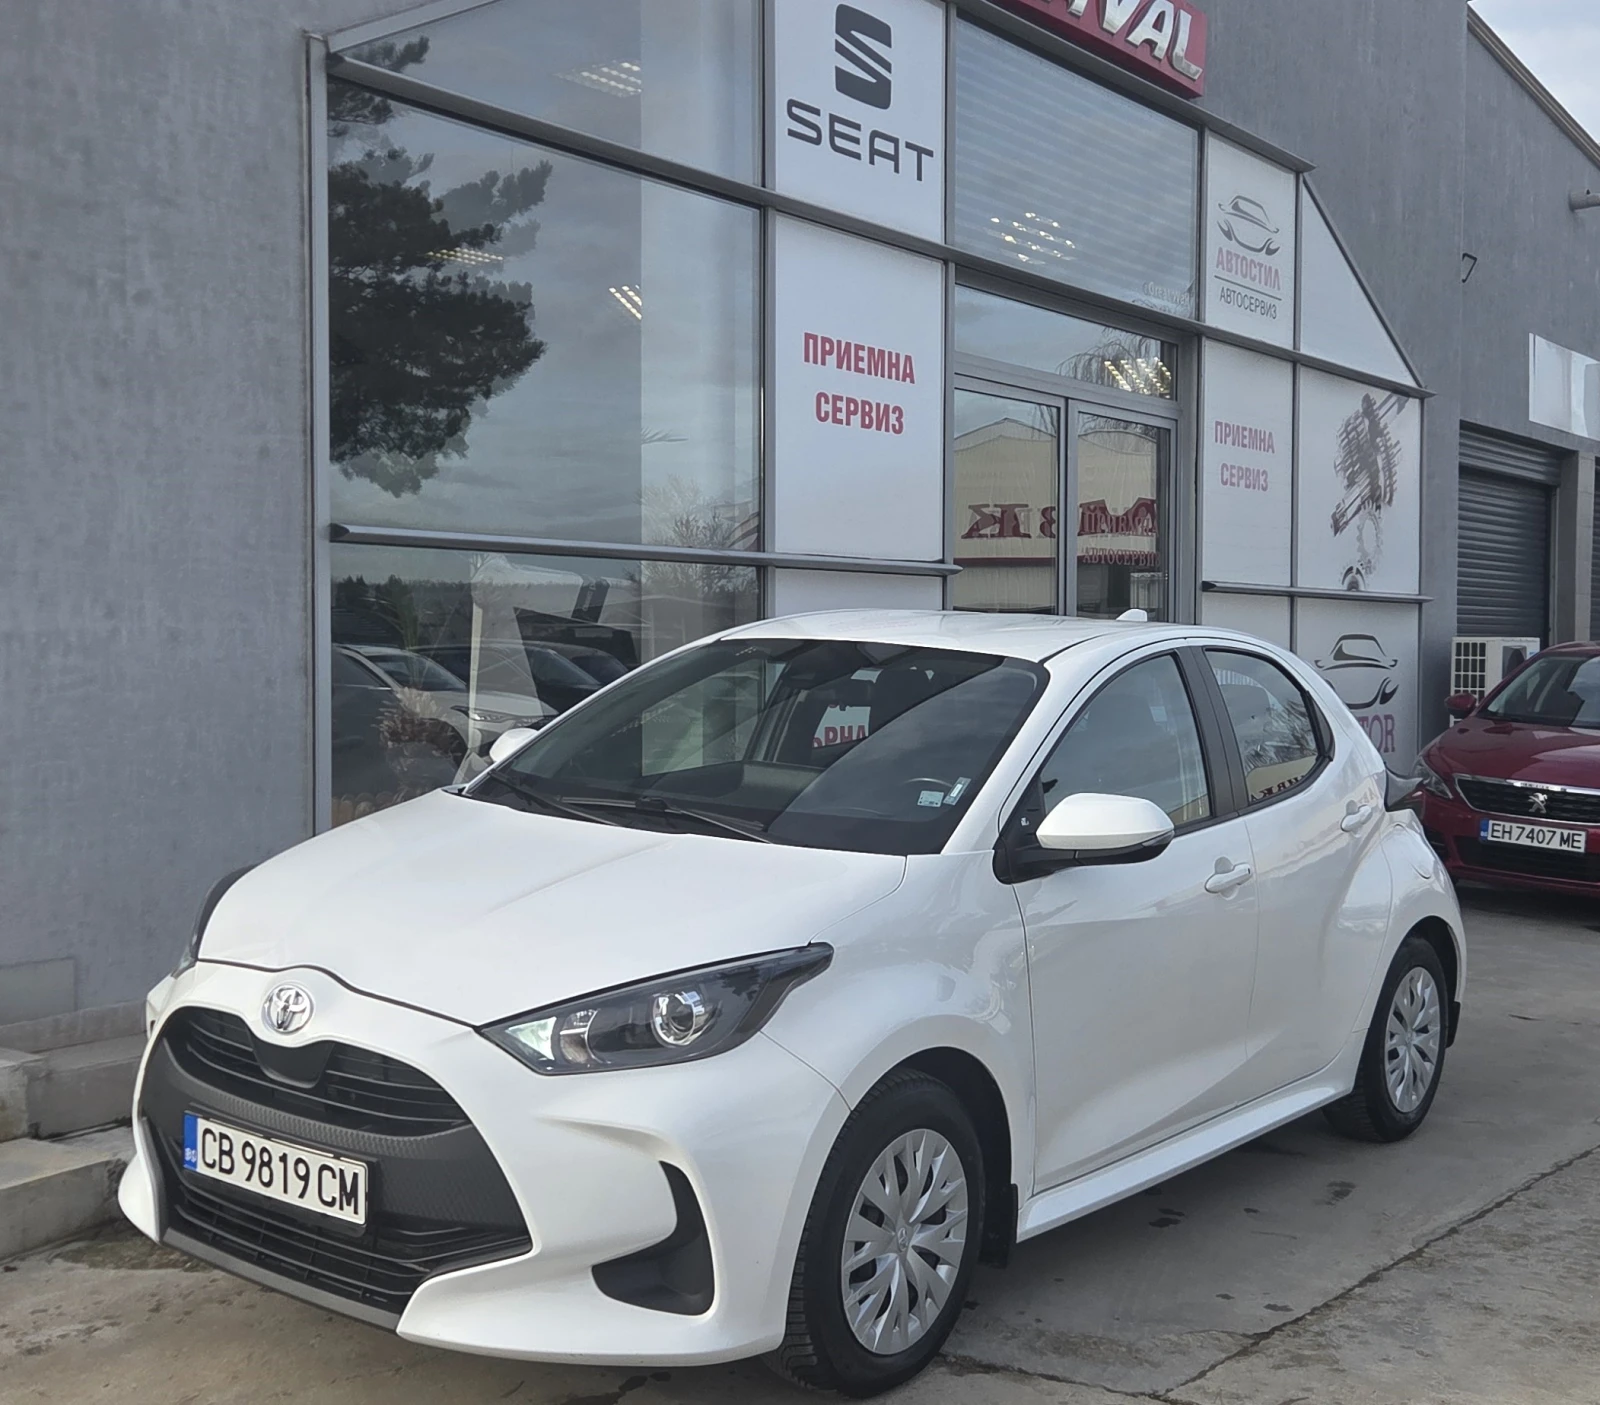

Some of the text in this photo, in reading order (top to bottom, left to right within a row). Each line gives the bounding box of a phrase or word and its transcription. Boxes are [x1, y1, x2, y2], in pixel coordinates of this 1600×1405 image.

[1068, 0, 1203, 81] VAL
[786, 98, 934, 182] SEAT
[1216, 246, 1281, 292] АВТОСТИЛ
[1219, 286, 1277, 320] АВТОСЕРВИЗ
[803, 332, 915, 384] ПРИЕМНА
[815, 391, 904, 435] СЕРВИЗ
[1214, 420, 1275, 454] ПРИЕМНА
[1220, 462, 1269, 492] СЕРВИЗ
[1515, 826, 1556, 846] 7407
[241, 1140, 311, 1199] 9819
